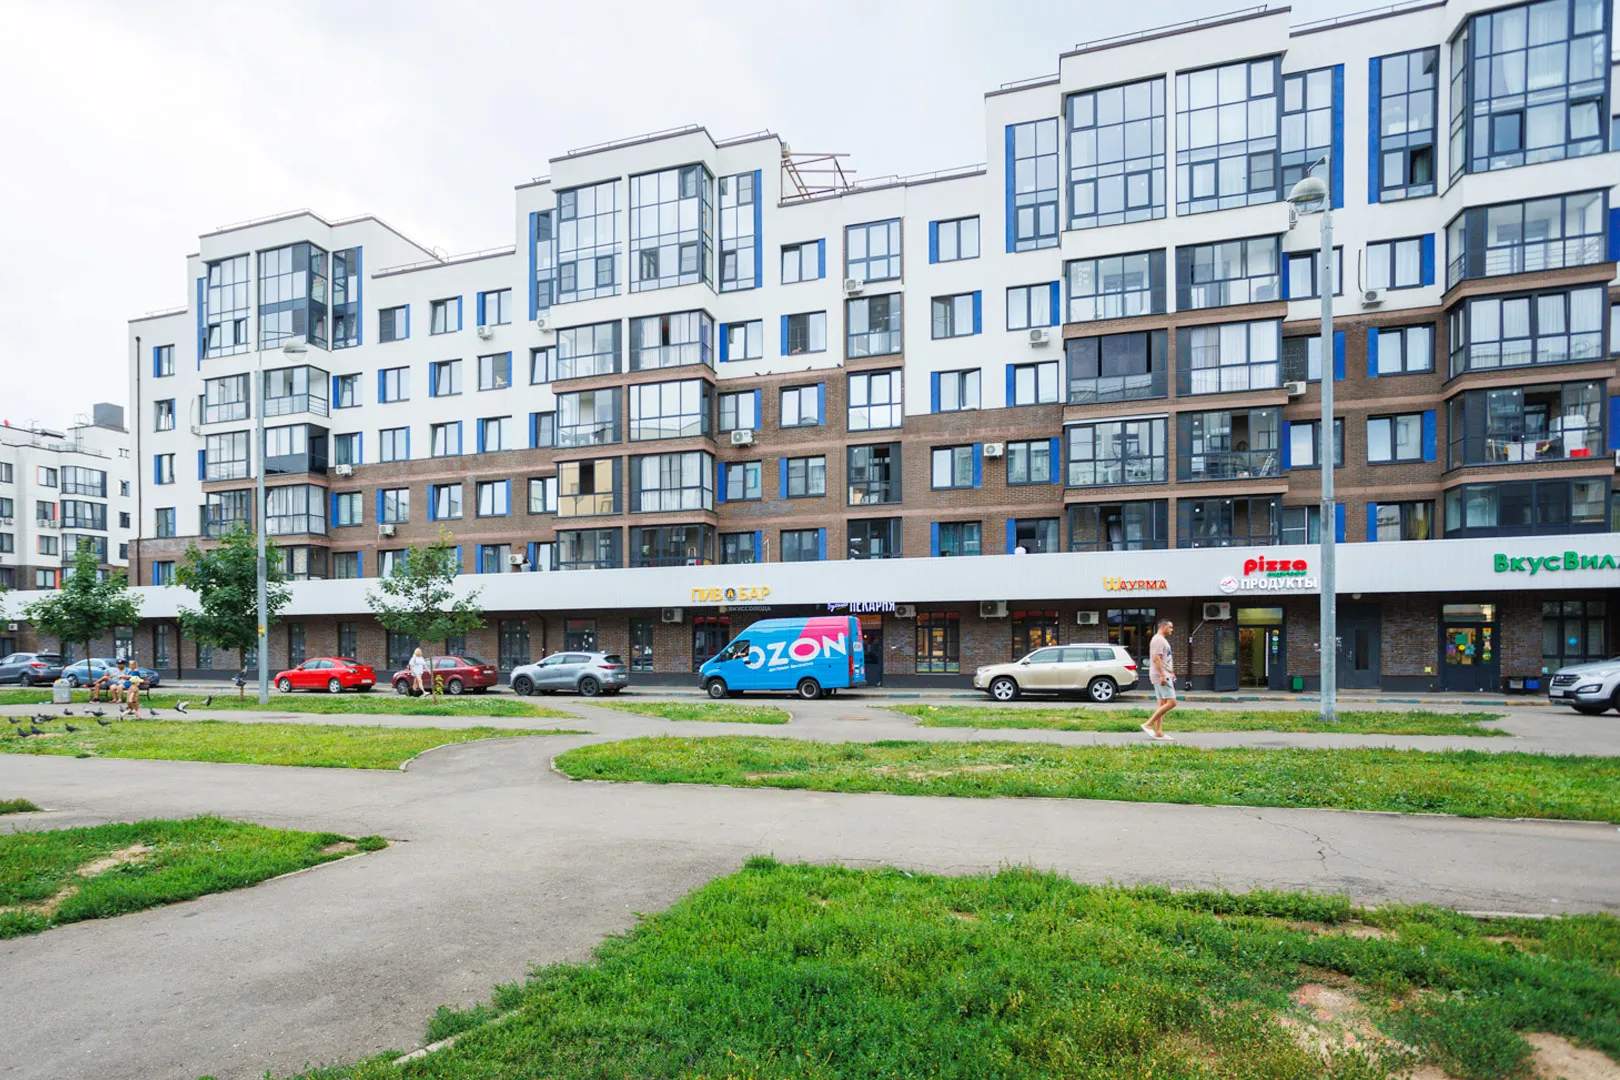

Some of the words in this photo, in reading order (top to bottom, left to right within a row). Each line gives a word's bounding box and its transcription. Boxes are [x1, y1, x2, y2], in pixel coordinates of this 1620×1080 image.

[1494, 551, 1620, 575] ВкусВил
[1103, 576, 1167, 591] ШАУРМА
[1240, 576, 1317, 590] ПРОДУКТЫ
[850, 600, 895, 612] ПЕКАРНЯ
[742, 632, 847, 670] OZON
